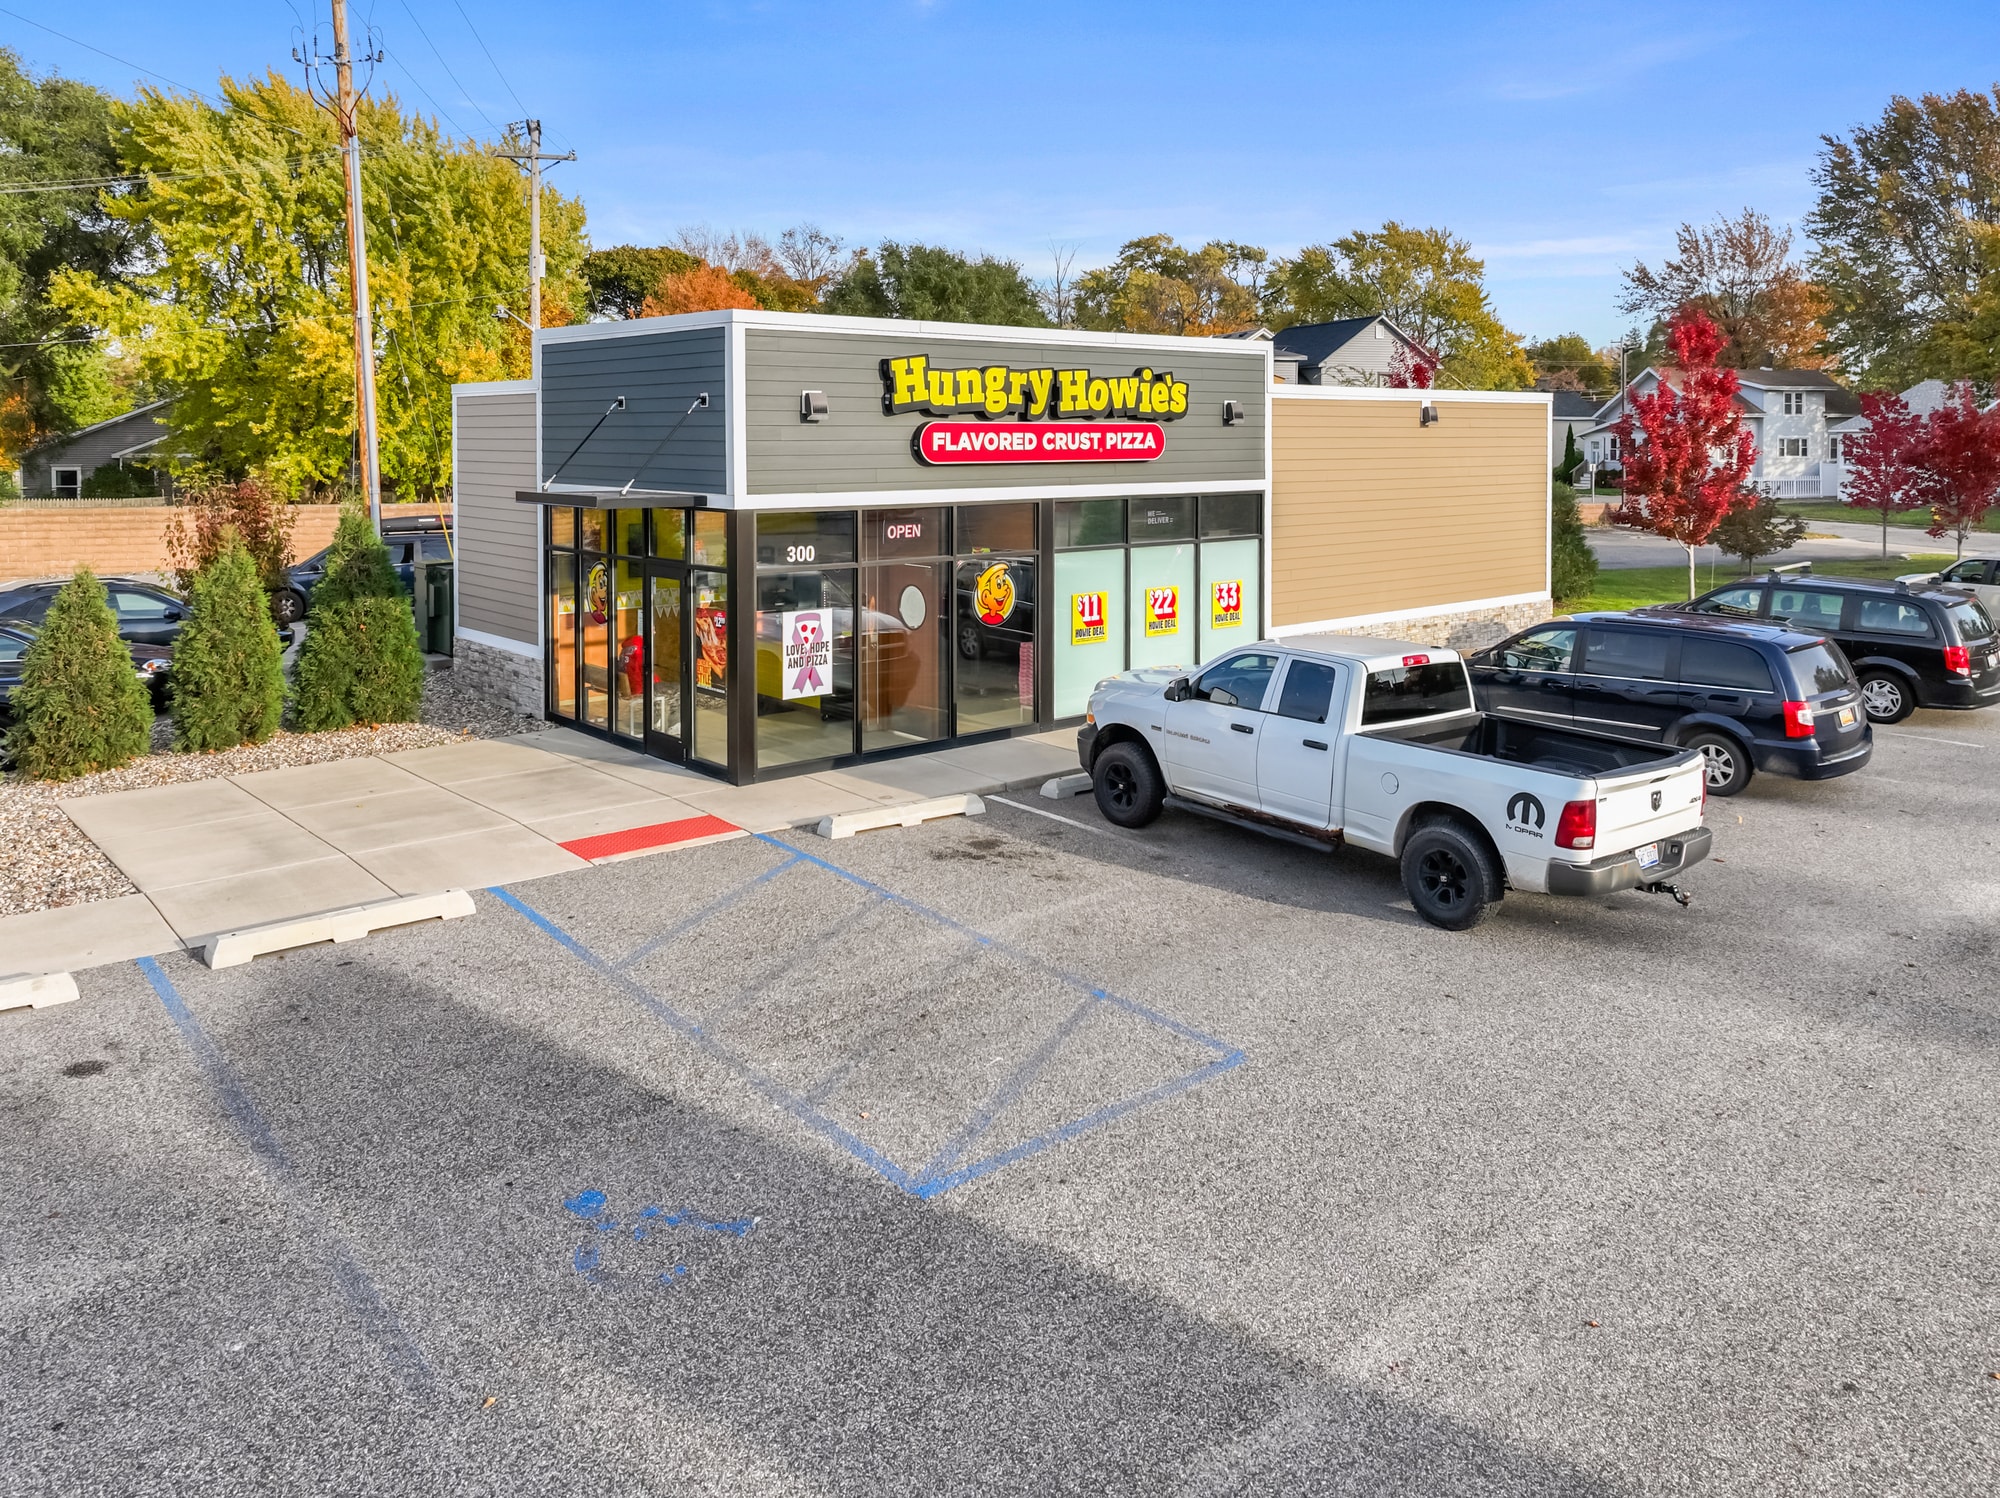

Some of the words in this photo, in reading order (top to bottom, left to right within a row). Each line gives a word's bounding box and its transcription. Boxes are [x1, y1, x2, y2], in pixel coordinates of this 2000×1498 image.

[889, 355, 1054, 416] Hungry
[1057, 367, 1189, 415] Howie's
[932, 431, 1038, 451] FLAVORED
[1042, 432, 1102, 451] CRUST
[1106, 431, 1157, 450] PIZZA
[1147, 516, 1170, 525] DELIVER
[886, 524, 922, 540] OPEN
[786, 545, 816, 563] 300
[1149, 587, 1174, 615] $22
[1215, 582, 1239, 608] $33
[1077, 594, 1101, 622] $11
[1148, 620, 1164, 630] HOWIE
[1164, 618, 1177, 629] DEAL
[1214, 613, 1229, 623] HOWIE
[1229, 611, 1241, 621] DEAL
[1075, 627, 1092, 638] HOWIE
[1092, 626, 1105, 636] DEAL
[786, 643, 808, 657] LOVE,
[809, 641, 830, 653] HOPE
[787, 656, 805, 669] AND
[806, 653, 829, 667] PIZZA
